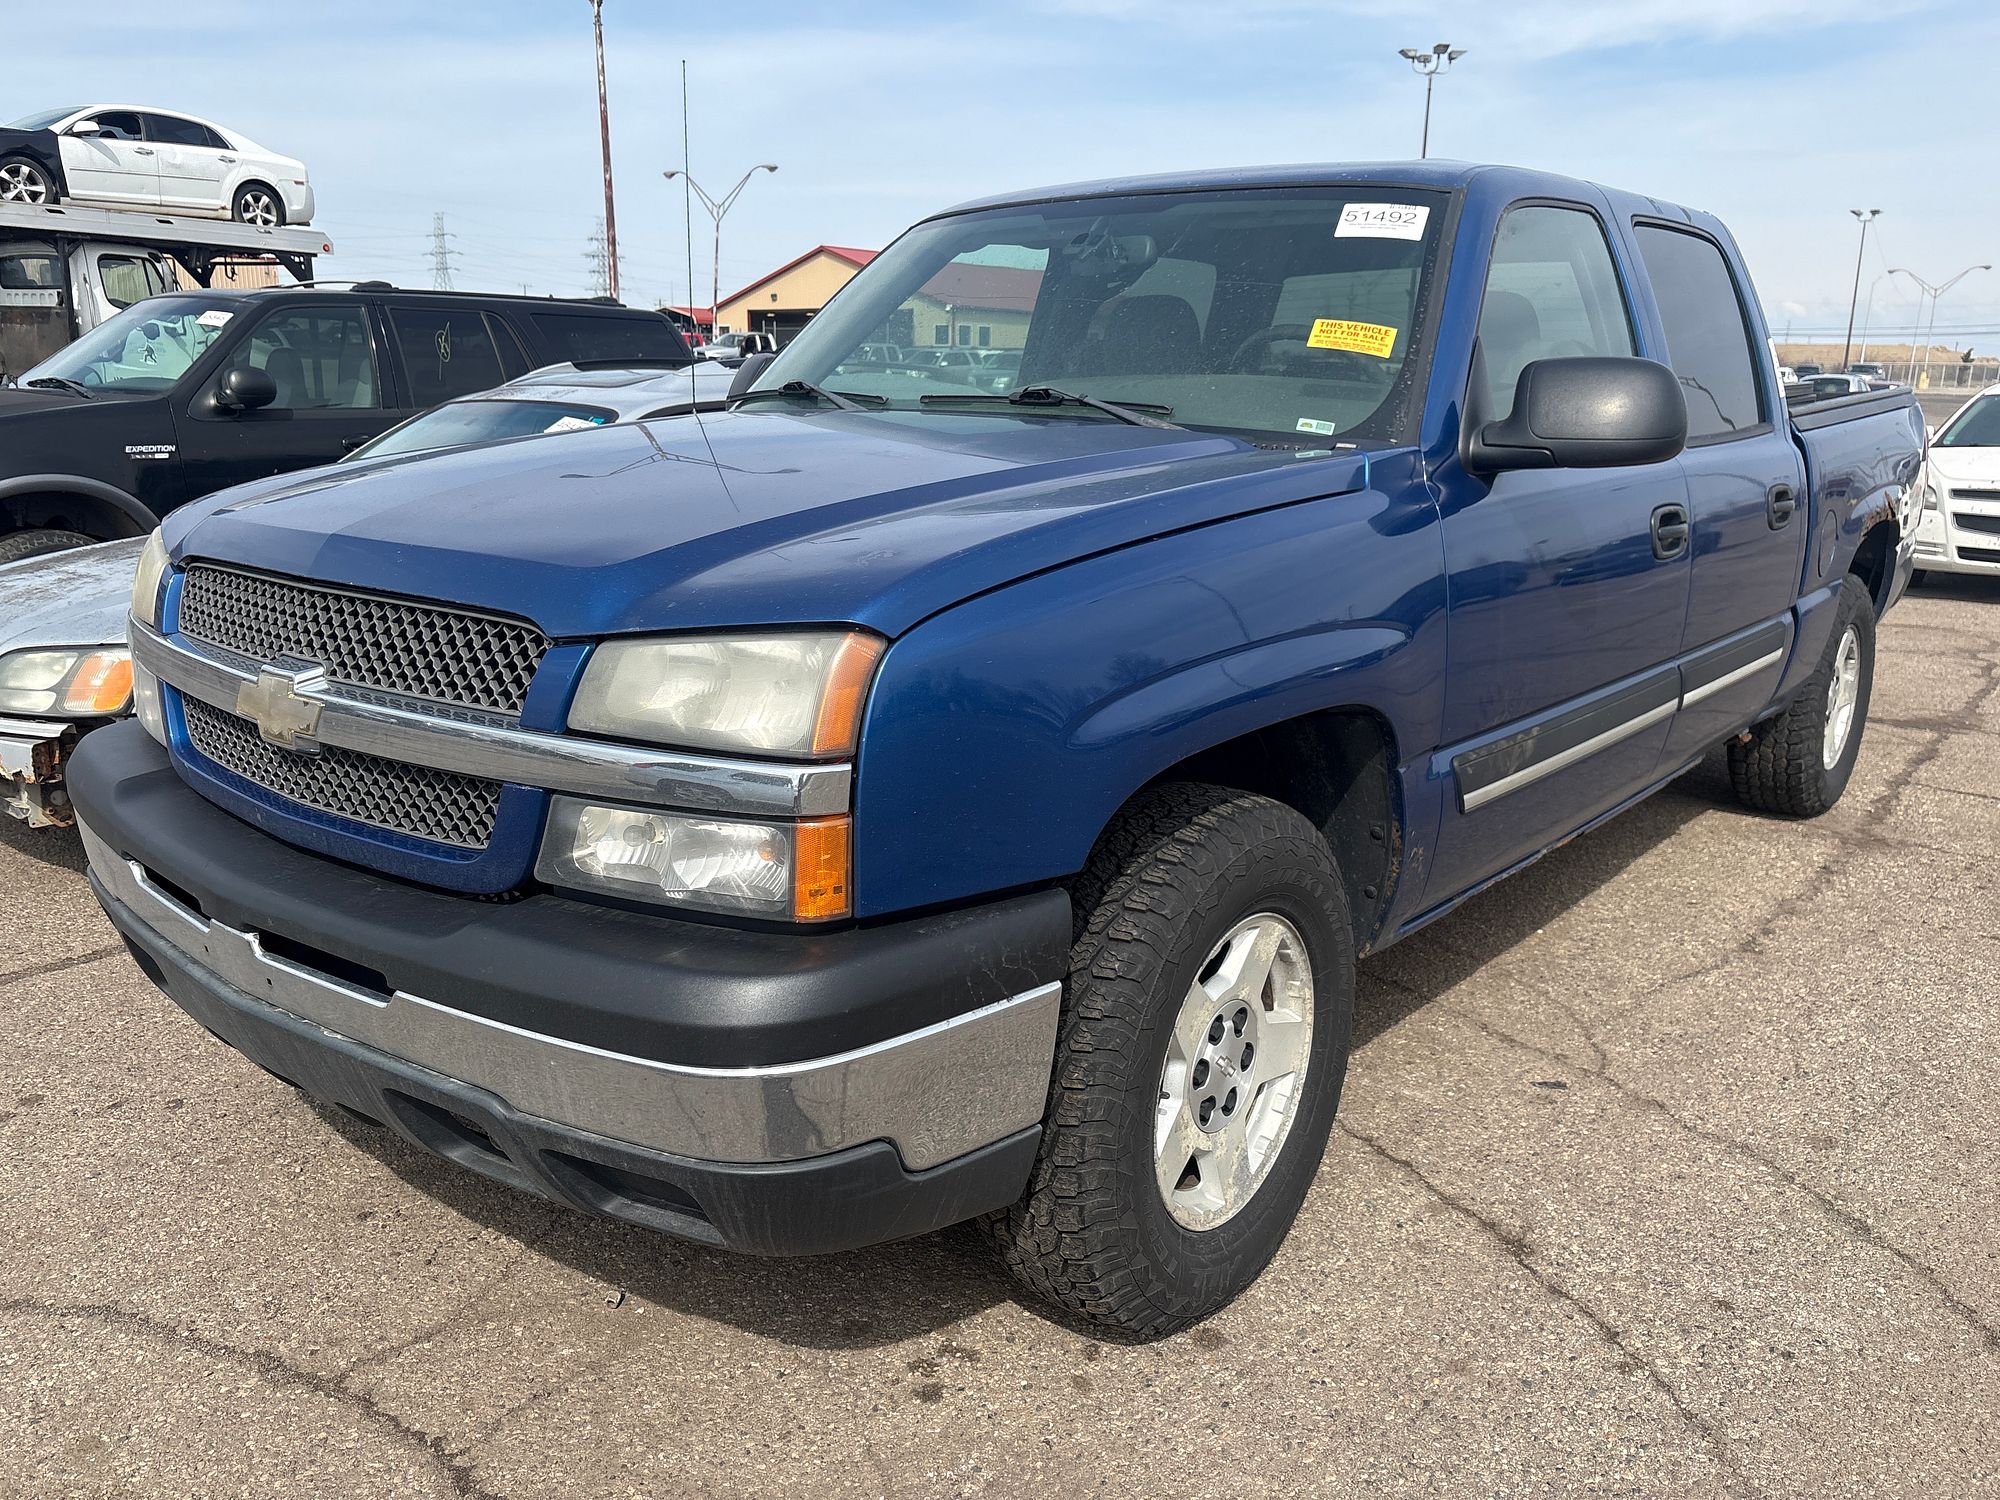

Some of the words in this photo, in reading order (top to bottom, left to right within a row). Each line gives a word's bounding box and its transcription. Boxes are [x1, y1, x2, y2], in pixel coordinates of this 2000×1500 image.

[1344, 211, 1417, 225] 51492
[1320, 321, 1343, 329] THIS
[1346, 324, 1391, 337] VEHICLE
[1340, 330, 1360, 338] FOR
[1362, 333, 1387, 342] SALE
[125, 445, 176, 453] EXPEDITION
